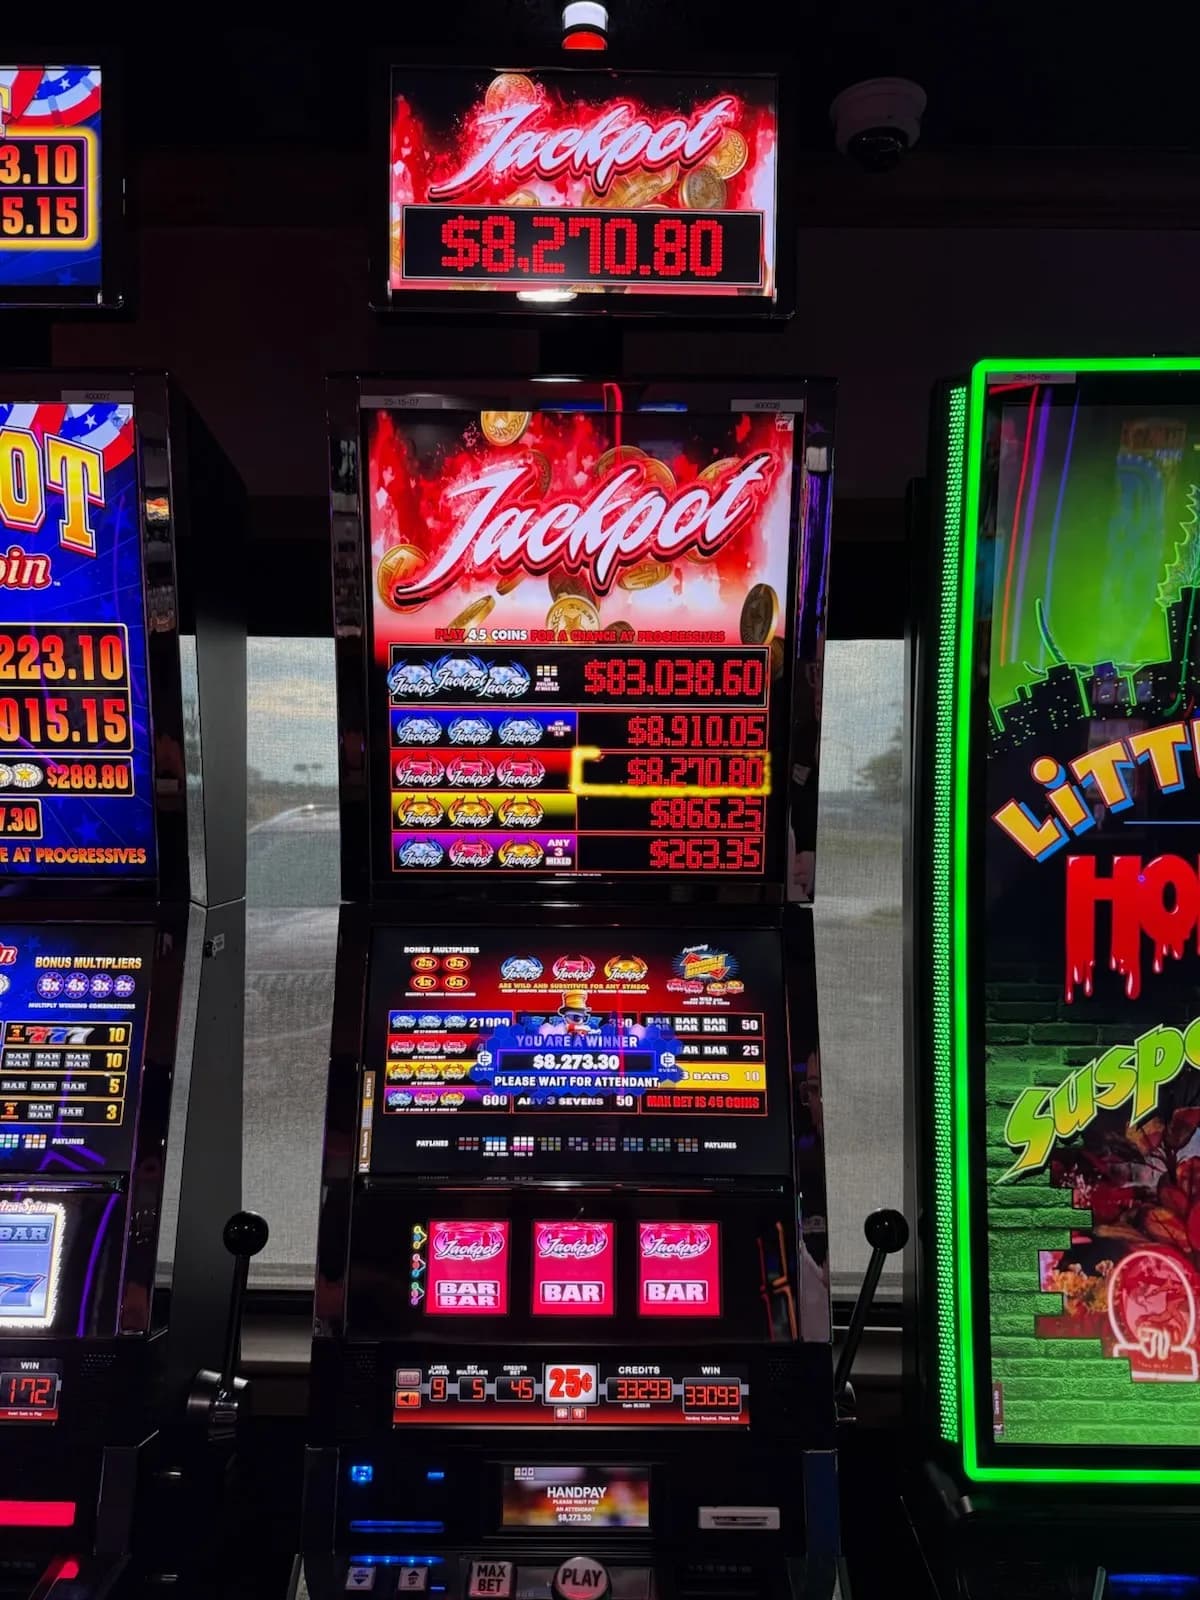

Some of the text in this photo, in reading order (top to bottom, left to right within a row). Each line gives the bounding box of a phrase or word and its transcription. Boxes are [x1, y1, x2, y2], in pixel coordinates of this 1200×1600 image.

[429, 98, 737, 197] Jackpot
[2, 197, 78, 234] 5.15
[441, 215, 724, 276] $8,270.80
[394, 452, 772, 588] Jackpot
[435, 629, 465, 642] PLAY
[491, 629, 527, 641] COINS
[530, 630, 554, 642] FOR
[558, 630, 568, 641] A
[571, 630, 616, 642] CHANCE
[620, 631, 635, 642] AT
[638, 631, 725, 643] PROGRESSIVES
[436, 670, 529, 697] Jackpot Jackpot
[584, 659, 763, 696] $83,038.60
[399, 728, 542, 745] Jackpot Jackpot Jackpot
[628, 715, 765, 747] $8,910.05
[47, 764, 129, 789] $288.80
[401, 769, 545, 787] Jackpot Jackpot Jackpot
[402, 811, 543, 828] Jackpot Jackpot Jackpot
[547, 839, 570, 847] ANY
[13, 848, 147, 864] AT PROGRESSIVES
[401, 851, 543, 868] Jackpot Jackpot Jackpot
[554, 848, 563, 856] 3
[650, 838, 761, 869] $263.35
[546, 857, 572, 866] MIXED
[1065, 854, 1200, 1004] HO
[35, 957, 142, 969] BONUS MULTIPLIERS
[67, 979, 86, 991] 4x
[92, 979, 110, 991] 3x
[115, 980, 132, 991] 2x
[703, 1017, 727, 1025] BAR
[741, 1019, 759, 1031] 50
[108, 1027, 126, 1042] 10
[516, 1035, 638, 1048] YOU ARE A WINNER
[703, 1045, 760, 1056] BAR 25
[106, 1053, 122, 1067] 10
[533, 1054, 620, 1070] $8,273.30
[495, 1076, 536, 1087] PLEASE
[539, 1077, 567, 1087] WAIT
[570, 1077, 592, 1087] FOR
[693, 1073, 730, 1081] BARS
[2, 1078, 120, 1094] BAR BAR BAR 5
[482, 1095, 508, 1106] 600
[558, 1097, 604, 1106] SEVENS
[616, 1095, 634, 1107] 50
[673, 1096, 693, 1107] BET
[28, 1111, 53, 1119] BAR
[59, 1107, 84, 1116] BAR
[106, 1105, 118, 1120] 3
[0, 1227, 47, 1241] BAR
[435, 1239, 501, 1260] Jackpot
[540, 1238, 605, 1259] Jackpot
[641, 1238, 706, 1259] Jackpot
[440, 1283, 496, 1294] BAR
[543, 1284, 601, 1302] BAR
[648, 1283, 705, 1302] BAR
[440, 1296, 495, 1306] BAR
[20, 1362, 40, 1370] WIN
[618, 1366, 660, 1375] CREDITS
[701, 1366, 721, 1375] WIN
[432, 1379, 445, 1399] 9
[472, 1379, 484, 1398] 5
[510, 1379, 533, 1398] 45
[549, 1368, 593, 1398] 25¢
[616, 1379, 671, 1399] 33293
[9, 1379, 51, 1404] 172
[685, 1386, 739, 1406] 33093
[547, 1486, 607, 1498] HANDPAY
[477, 1564, 506, 1577] MAX
[560, 1567, 602, 1587] PLAY
[478, 1578, 504, 1592] BET
